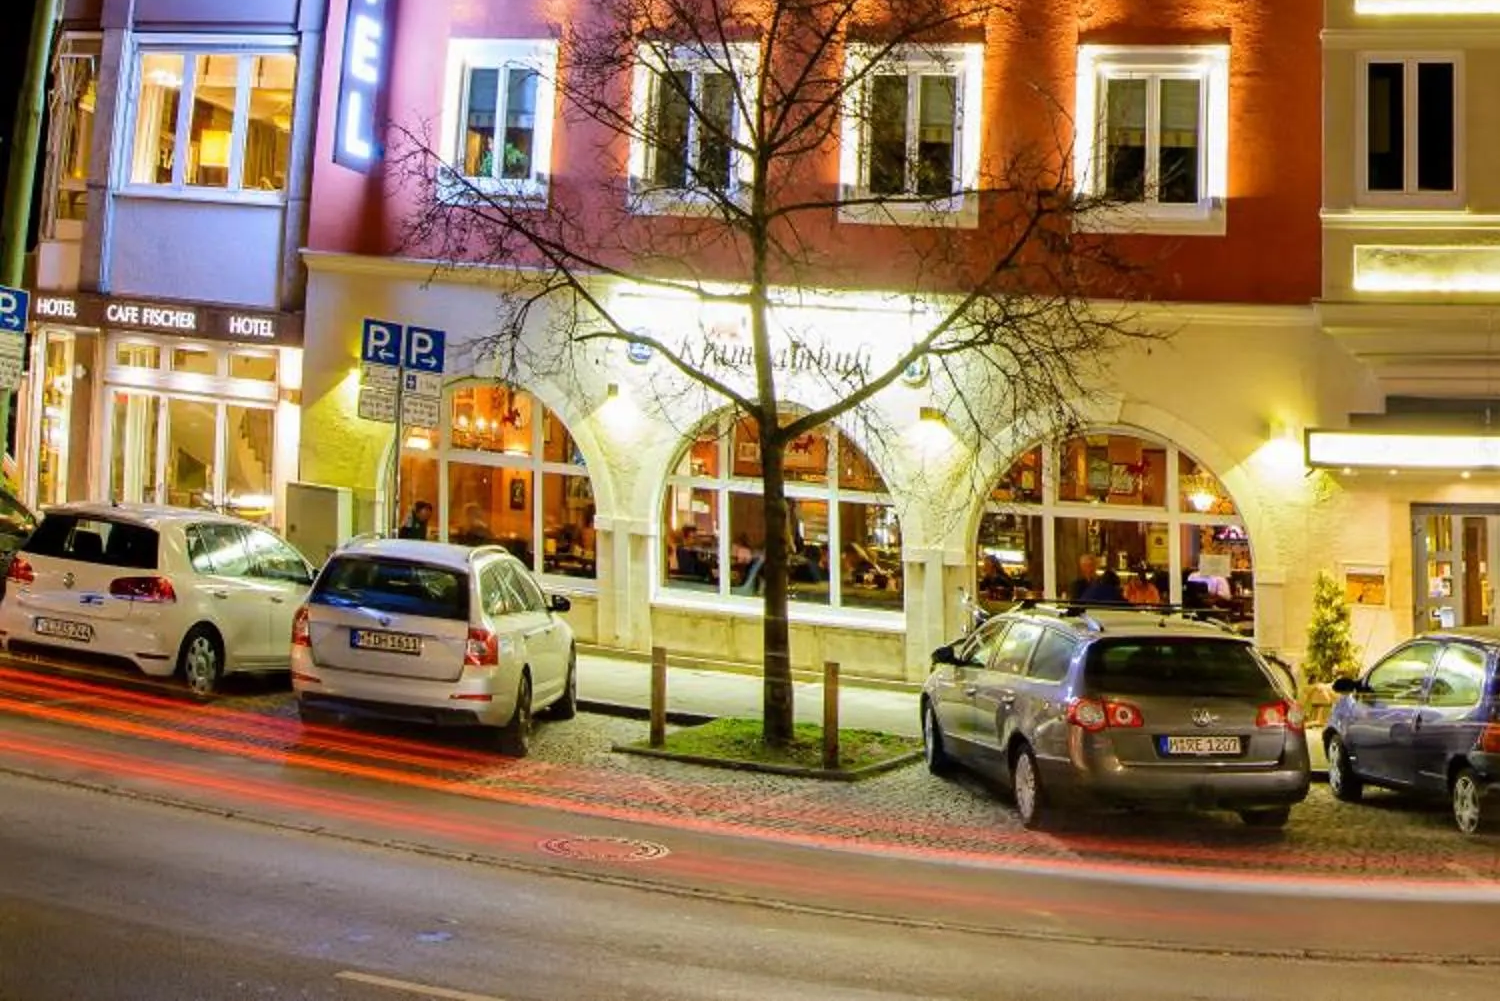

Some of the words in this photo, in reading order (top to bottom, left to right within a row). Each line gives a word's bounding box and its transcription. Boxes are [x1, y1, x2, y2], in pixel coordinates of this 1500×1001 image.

[36, 298, 77, 318] HOTEL
[106, 303, 139, 324] CAFE
[142, 307, 196, 330] FISCHER
[229, 315, 275, 338] HOTEL
[367, 324, 390, 358] P
[411, 331, 434, 365] P
